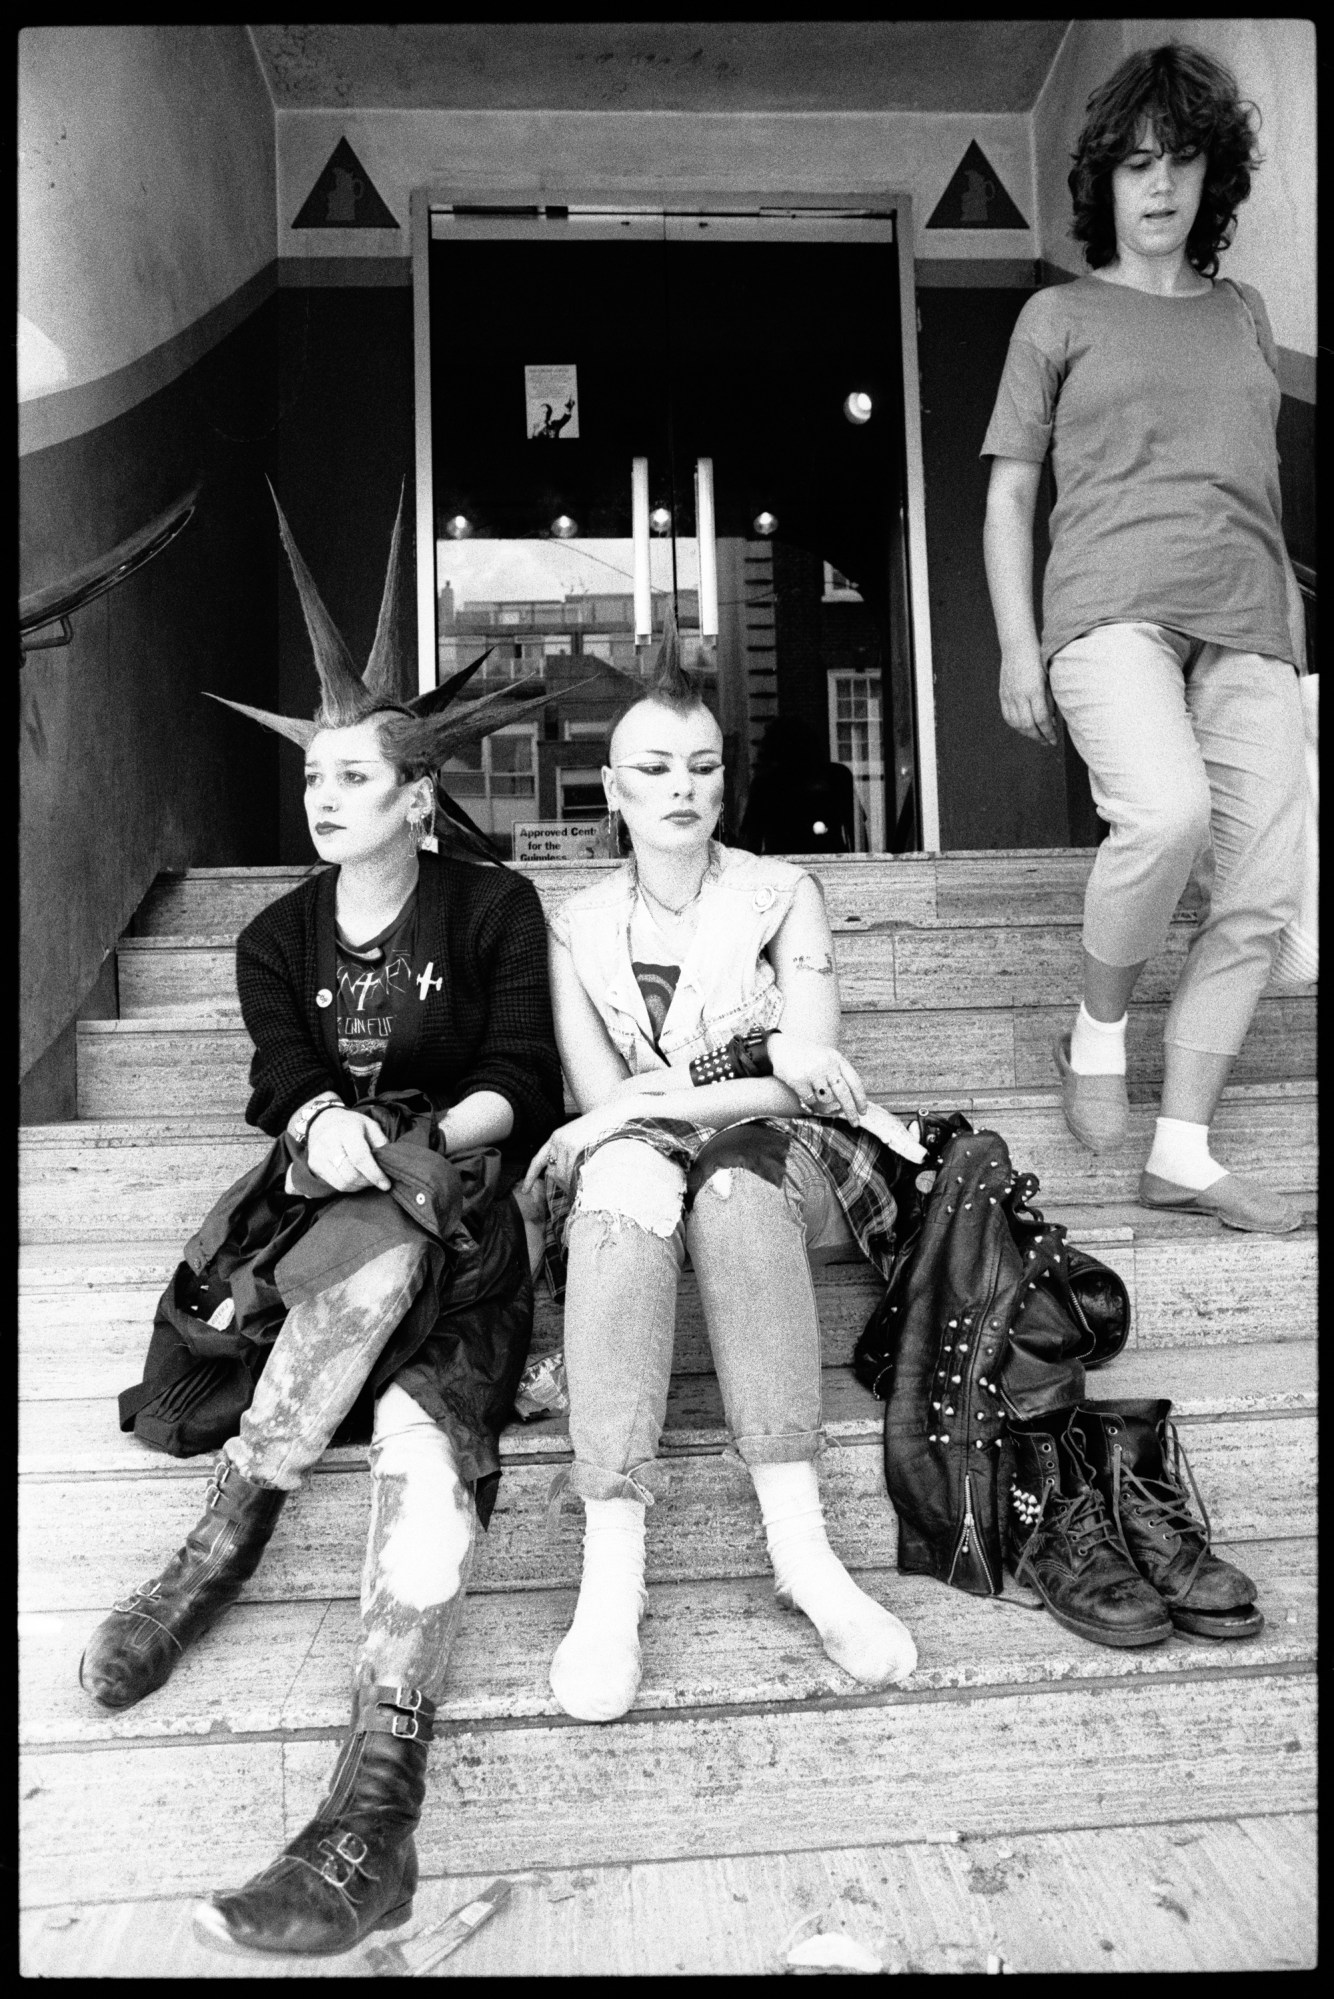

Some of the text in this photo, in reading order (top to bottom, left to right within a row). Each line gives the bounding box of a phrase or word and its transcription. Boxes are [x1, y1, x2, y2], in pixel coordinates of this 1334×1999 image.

[520, 827, 567, 838] Approved
[528, 841, 561, 850] for the
